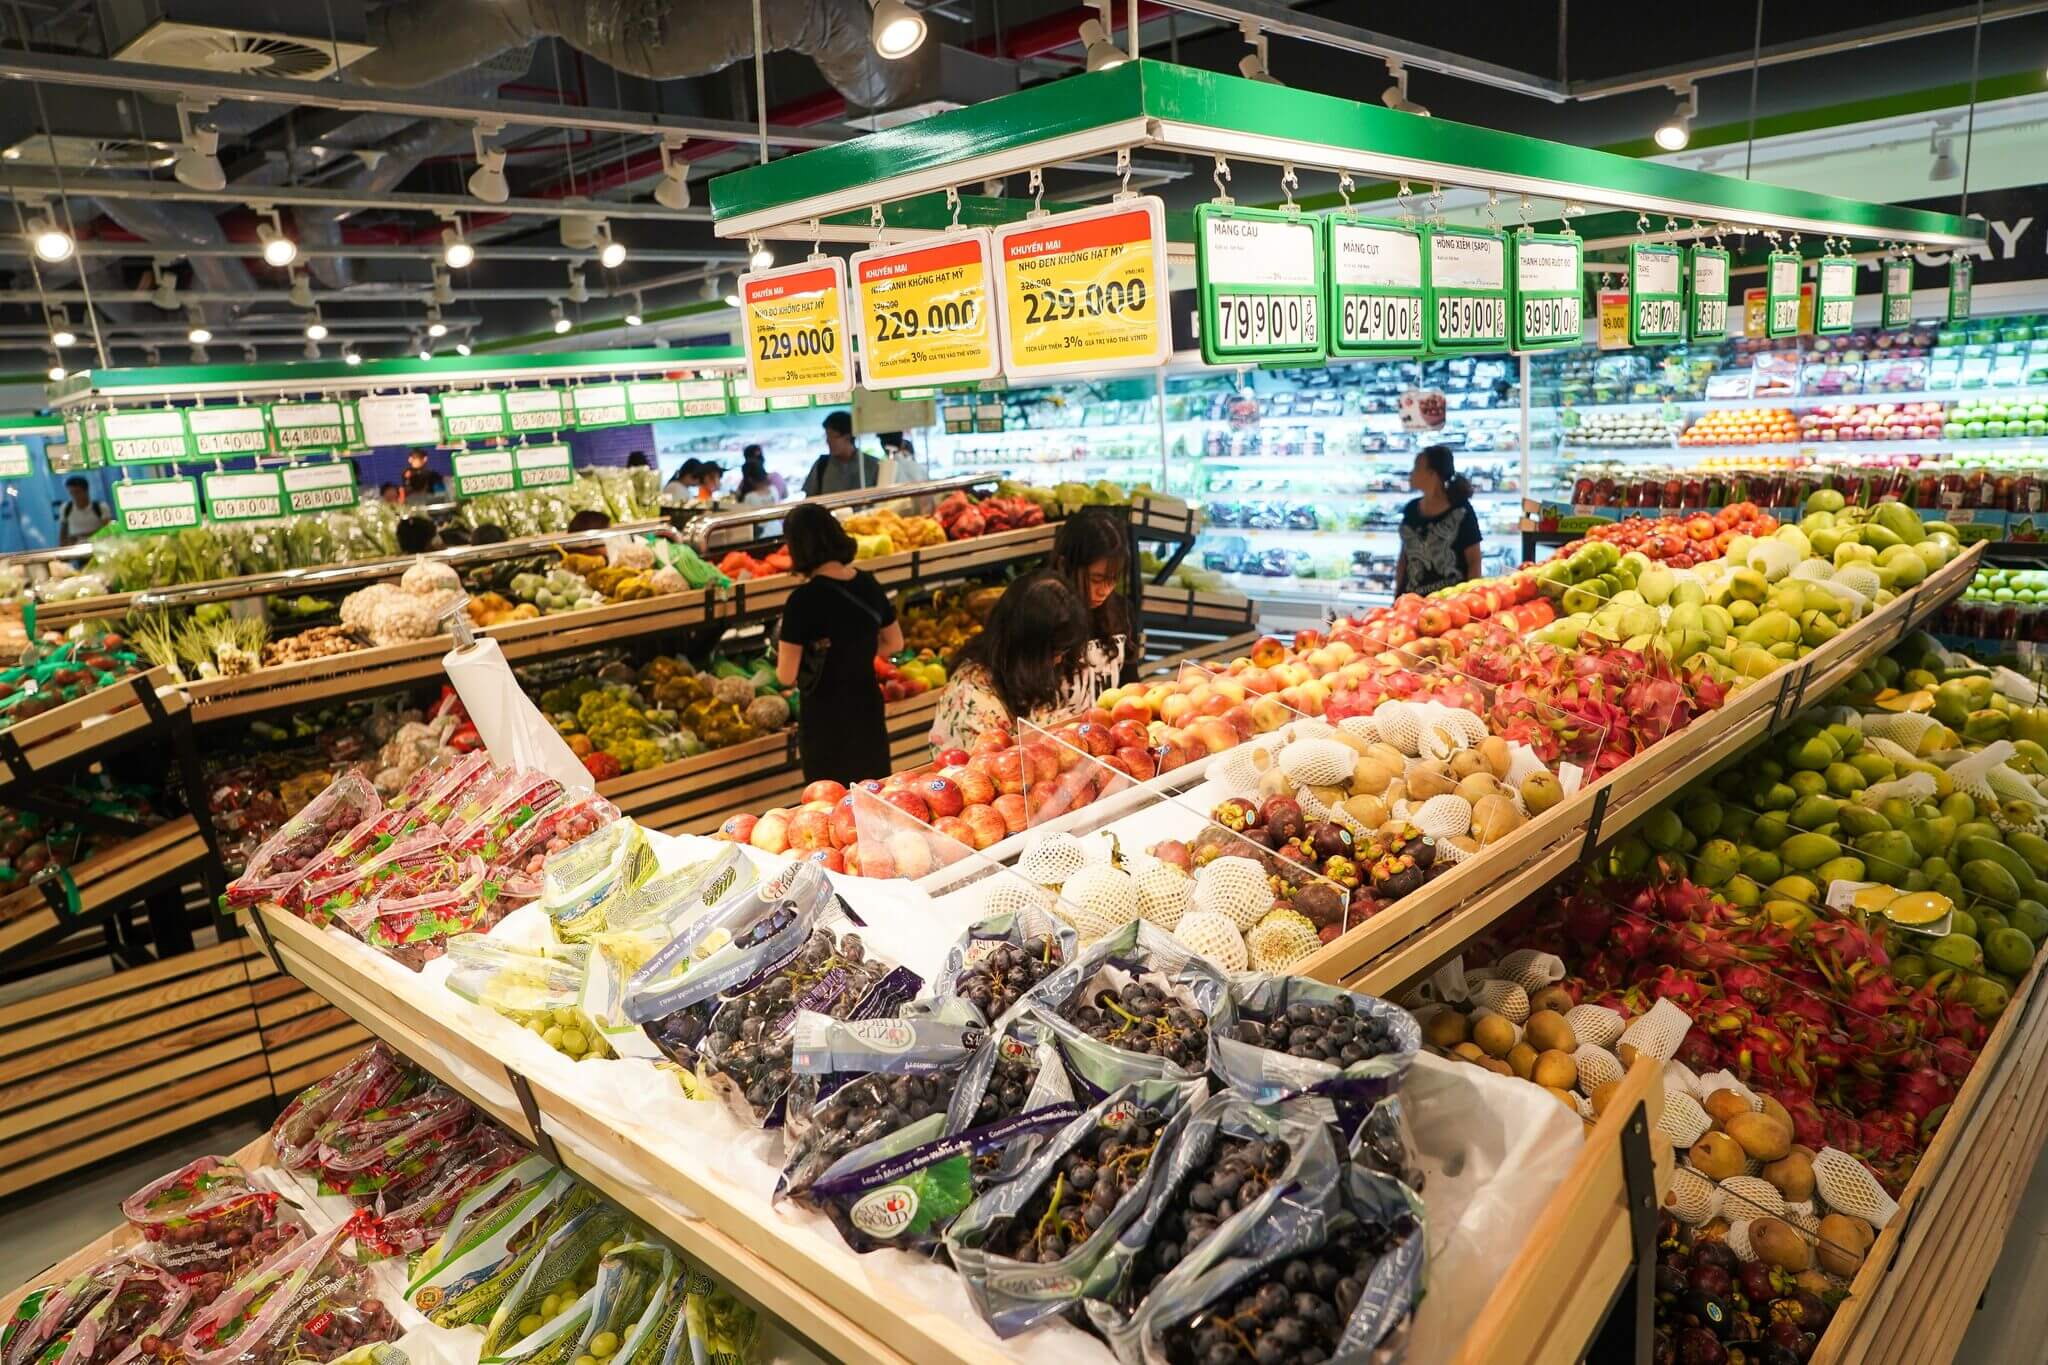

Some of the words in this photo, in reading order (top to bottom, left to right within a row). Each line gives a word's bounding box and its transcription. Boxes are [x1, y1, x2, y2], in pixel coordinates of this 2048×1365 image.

[1010, 241, 1044, 257] KHUYẾN
[1045, 239, 1061, 251] MẠI
[866, 264, 893, 279] KHUYẾN
[1018, 261, 1037, 273] NHO
[1038, 257, 1056, 270] ĐEN
[1058, 250, 1089, 266] KHÔNG
[1091, 249, 1108, 262] HẠT
[908, 275, 934, 289] KHÔNG
[935, 271, 951, 284] HẠT
[952, 267, 965, 280] MỸ
[1023, 278, 1147, 325] 229.000
[875, 299, 978, 343] 229.000
[758, 326, 835, 361] 229.000
[1063, 336, 1083, 349] 3%
[911, 351, 928, 363] 3%
[860, 1171, 884, 1185] Learn
[883, 1163, 904, 1181] More
[858, 1200, 887, 1218] SUN
[860, 1209, 908, 1230] WORLD
